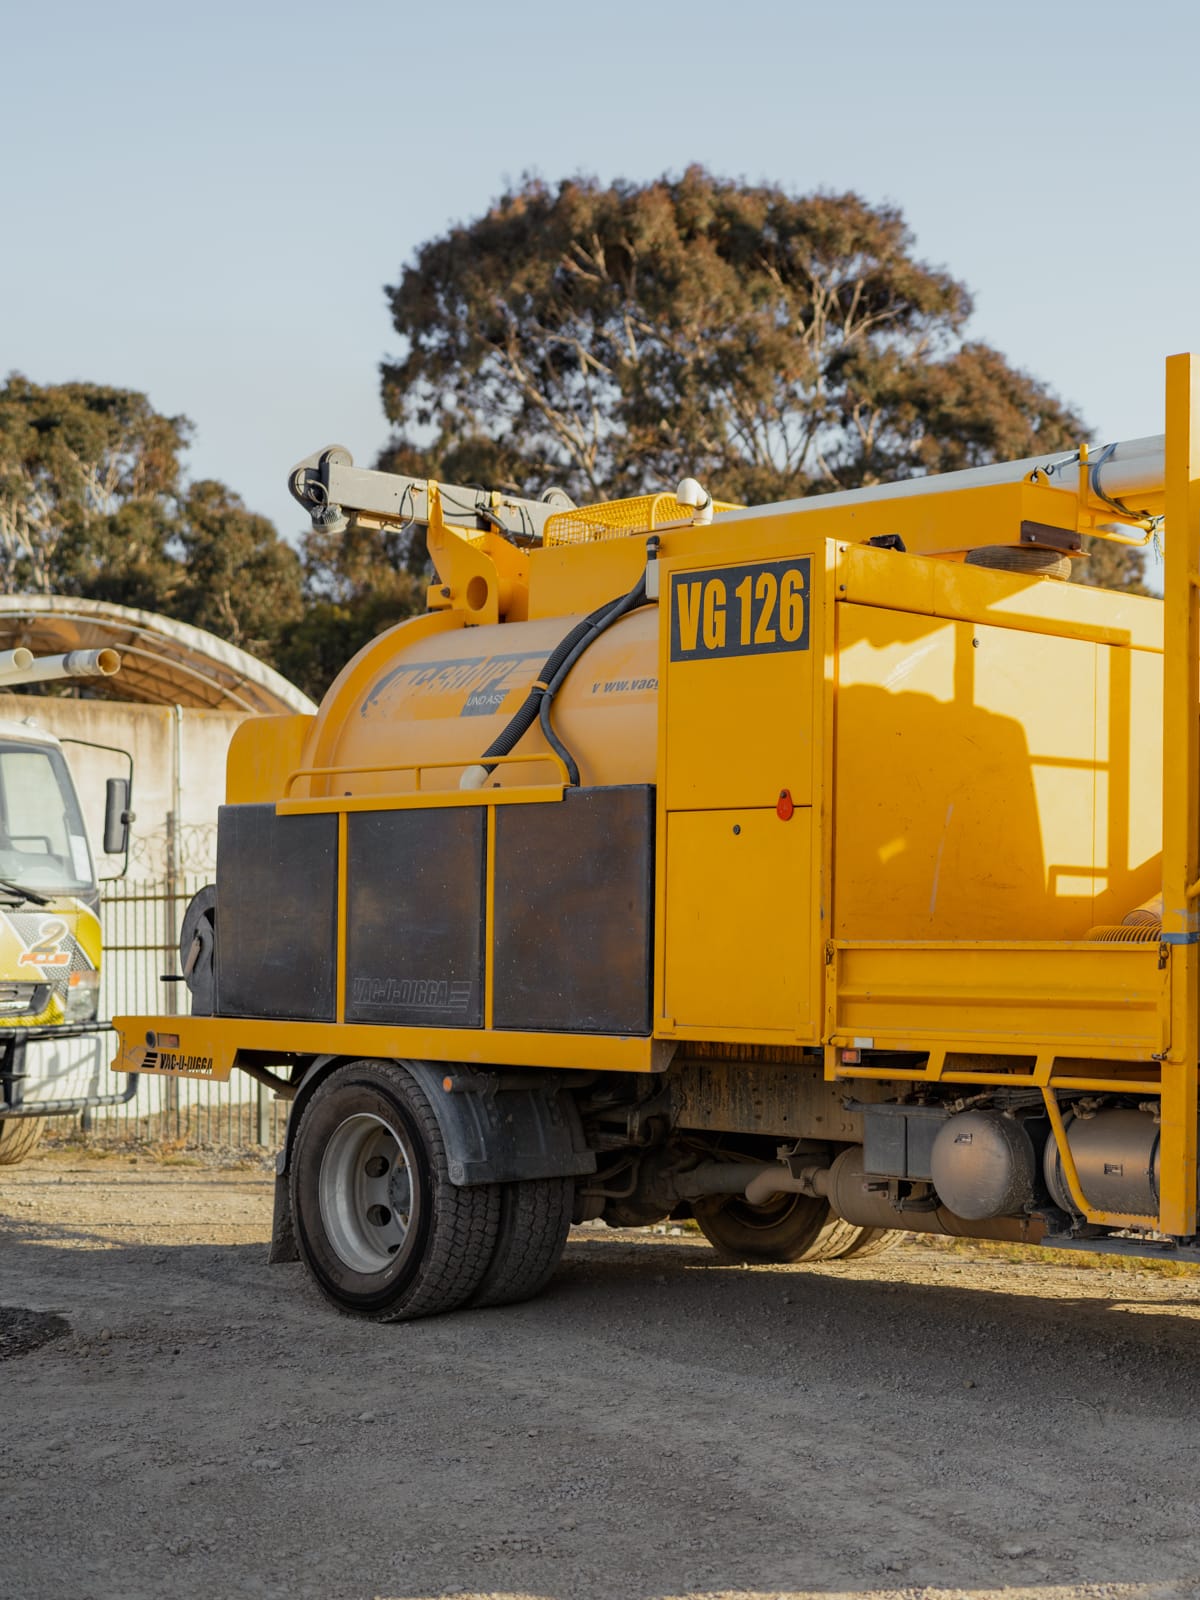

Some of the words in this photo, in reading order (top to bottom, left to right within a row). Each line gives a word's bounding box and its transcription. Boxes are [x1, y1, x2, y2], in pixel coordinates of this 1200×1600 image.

[676, 578, 727, 651] VG
[735, 568, 805, 643] 126
[31, 921, 67, 954] 2
